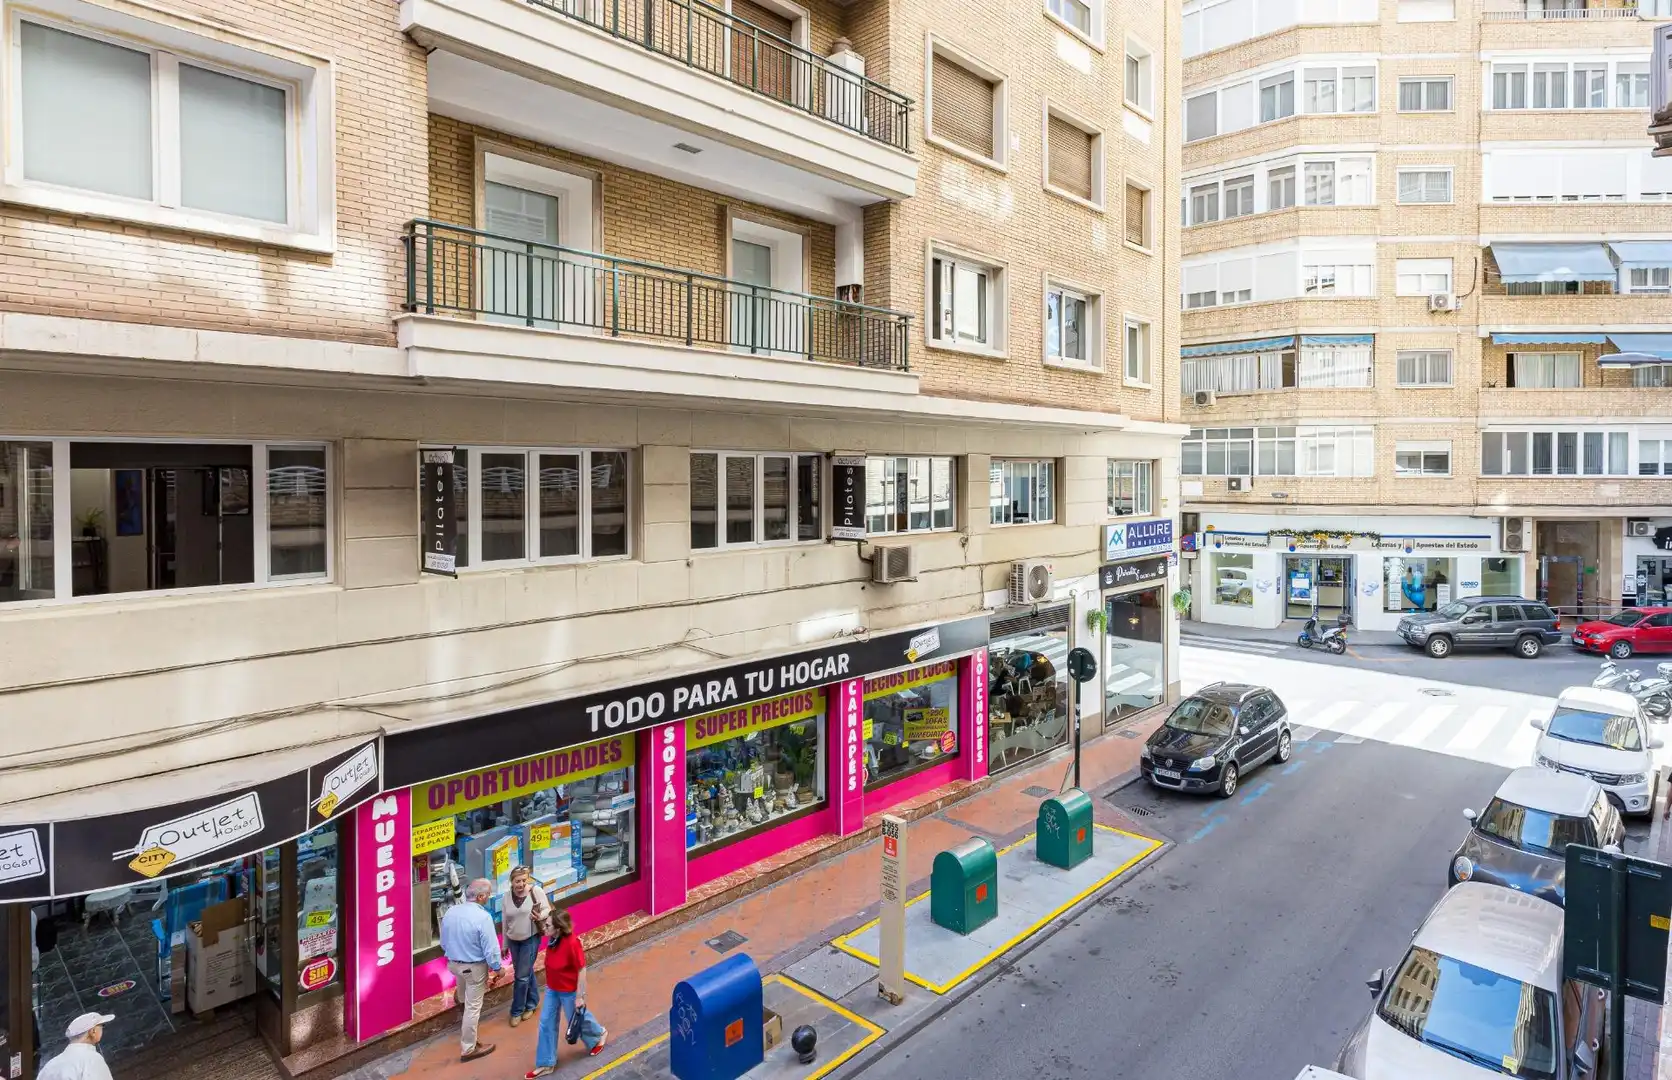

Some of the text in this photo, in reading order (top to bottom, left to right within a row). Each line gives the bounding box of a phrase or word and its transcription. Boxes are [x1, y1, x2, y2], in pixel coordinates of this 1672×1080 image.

[1128, 523, 1170, 539] ALLURE
[1416, 542, 1444, 550] Apuestas
[586, 653, 850, 733] TODO PARA TU HOGAR
[863, 672, 904, 694] RECIOS
[907, 667, 921, 683] DE
[695, 692, 813, 740] SUPER PRECIOS
[848, 681, 857, 791] CANAPÉS
[908, 731, 942, 739] INMEDIAT
[331, 756, 369, 790] Outlet
[428, 739, 622, 810] OPORTUNIDADES
[663, 726, 676, 821] SOFÁS
[160, 808, 244, 846] Outlet
[415, 835, 450, 849] DE PLAYA
[426, 829, 451, 841] ZONAS
[139, 852, 167, 863] CITY
[372, 795, 398, 967] MUEBLES
[309, 965, 328, 980] SIN
